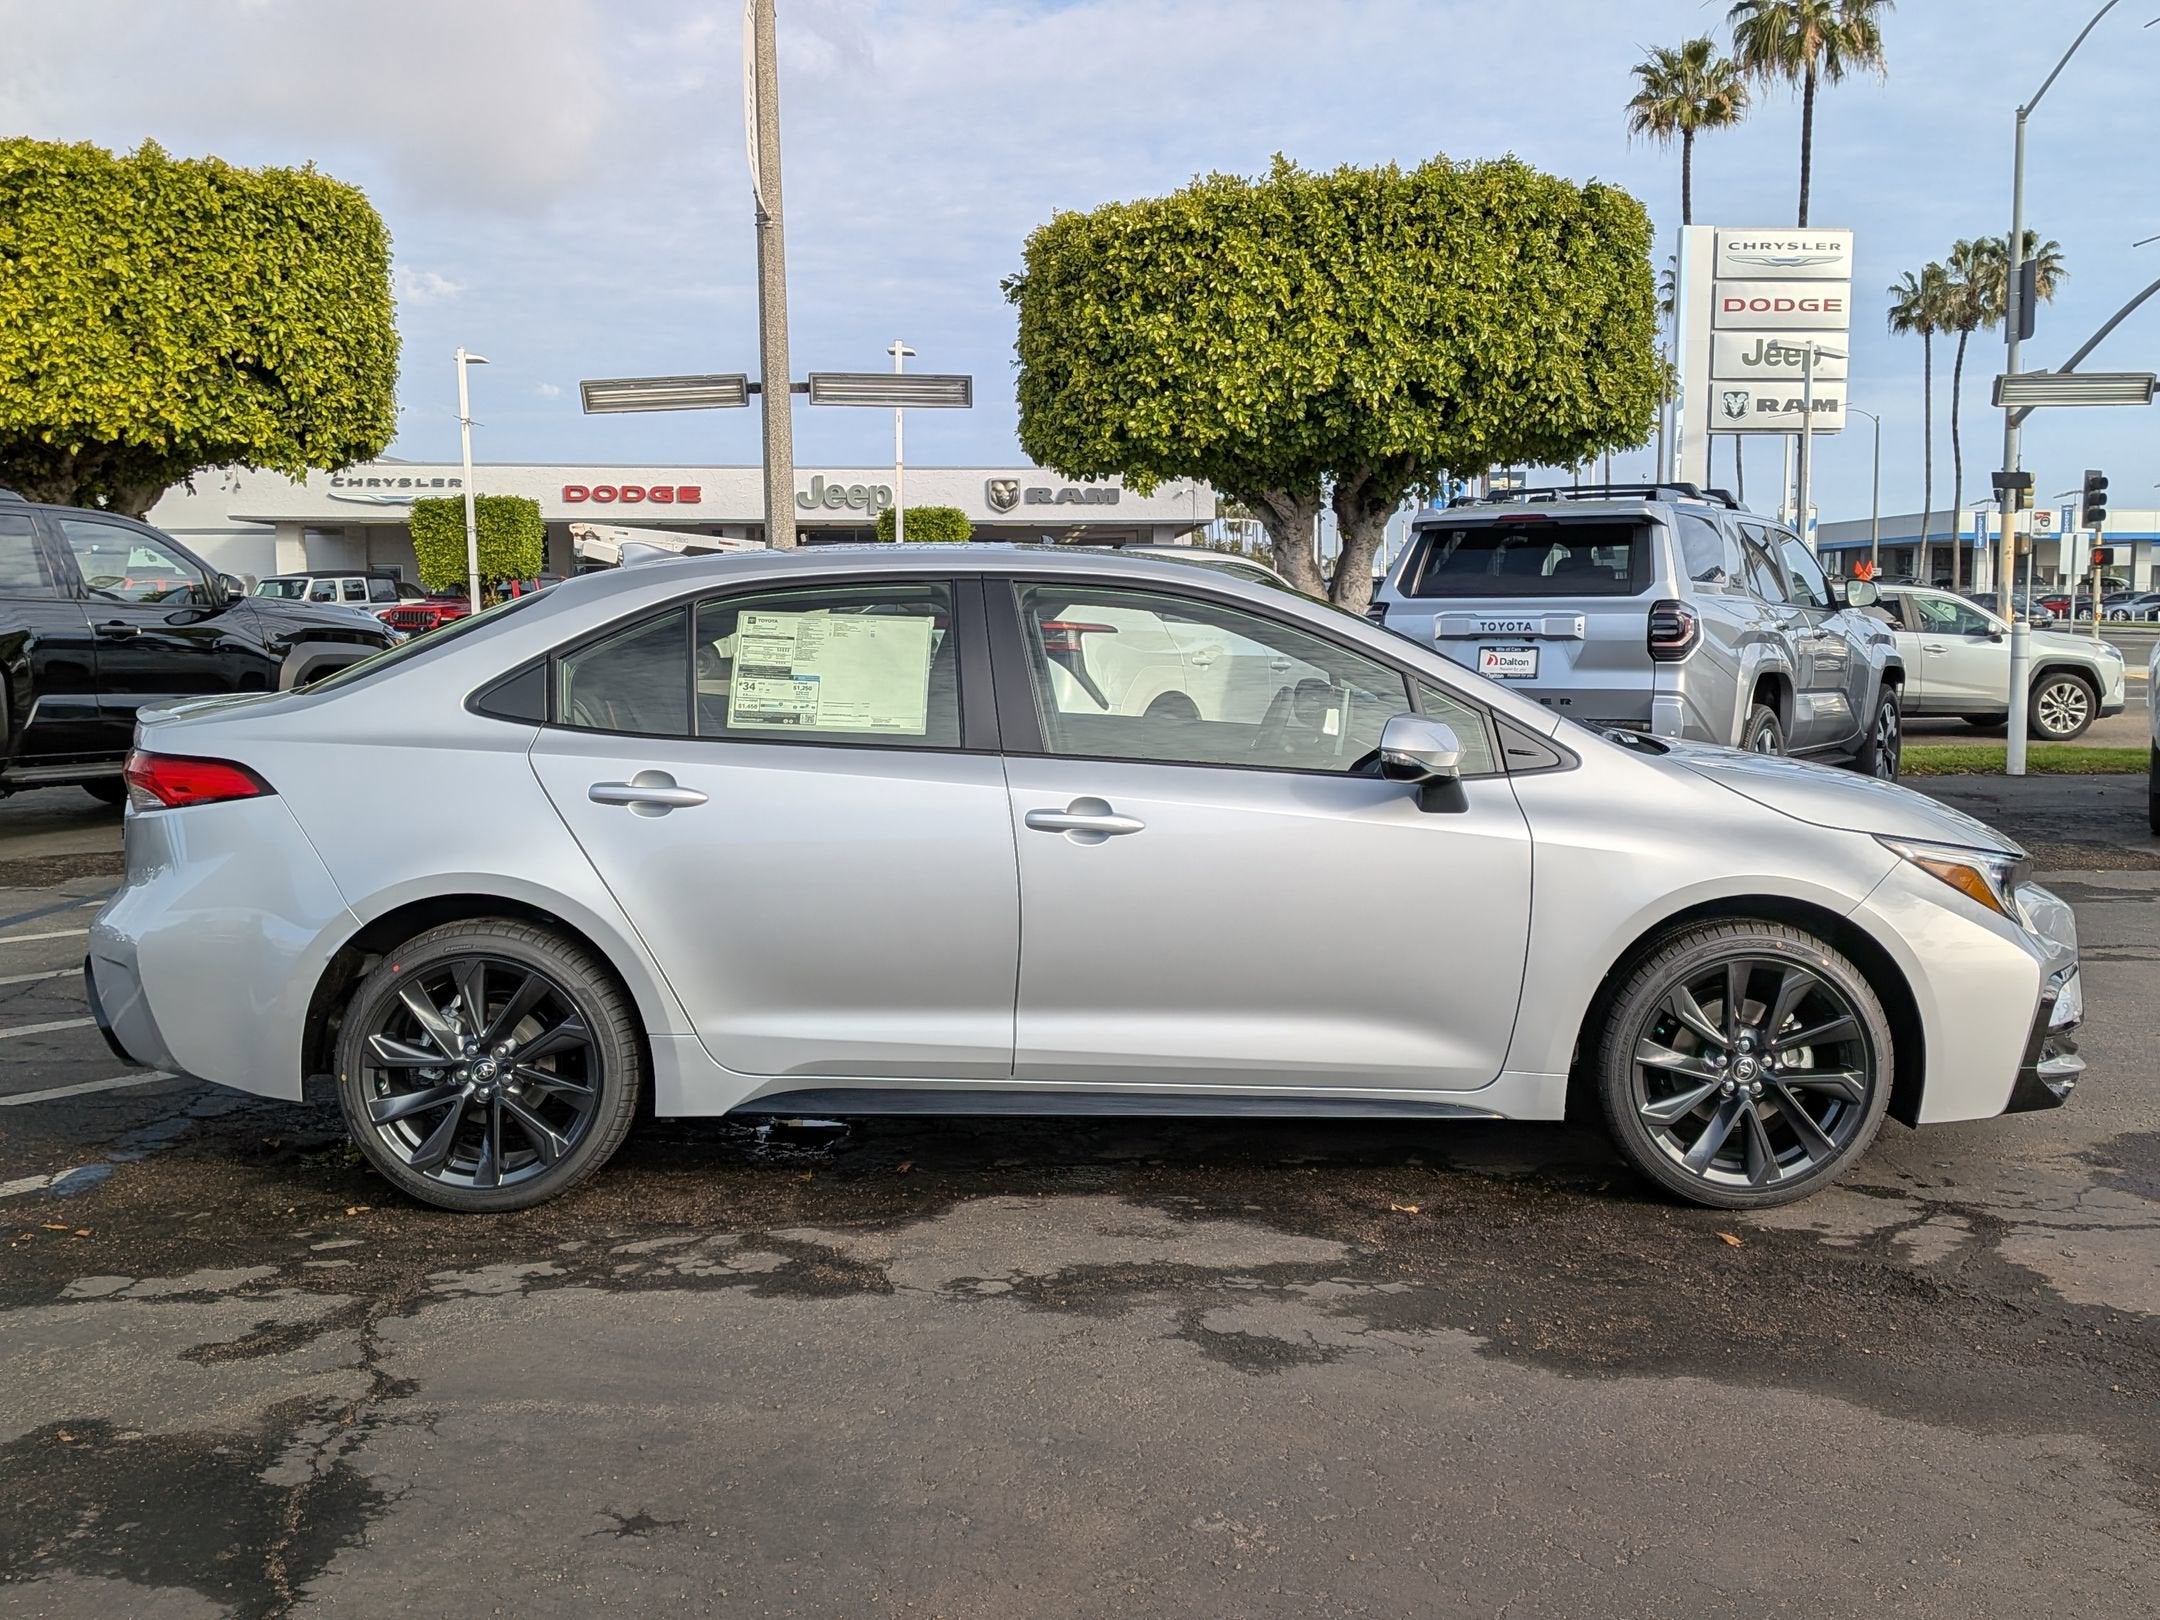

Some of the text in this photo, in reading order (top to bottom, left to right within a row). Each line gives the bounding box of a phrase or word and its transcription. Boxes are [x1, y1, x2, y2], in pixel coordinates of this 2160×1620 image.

[1728, 242, 1841, 250] CHRYSLER
[1724, 298, 1842, 312] DODGE
[1756, 398, 1838, 412] RAM
[330, 477, 463, 488] CHRYSLER
[562, 485, 702, 504] DODGE
[796, 475, 892, 516] Jeep
[1024, 488, 1120, 505] RAM
[1480, 622, 1533, 631] TOYOTA
[1500, 657, 1529, 666] Dalton
[742, 681, 756, 691] 34
